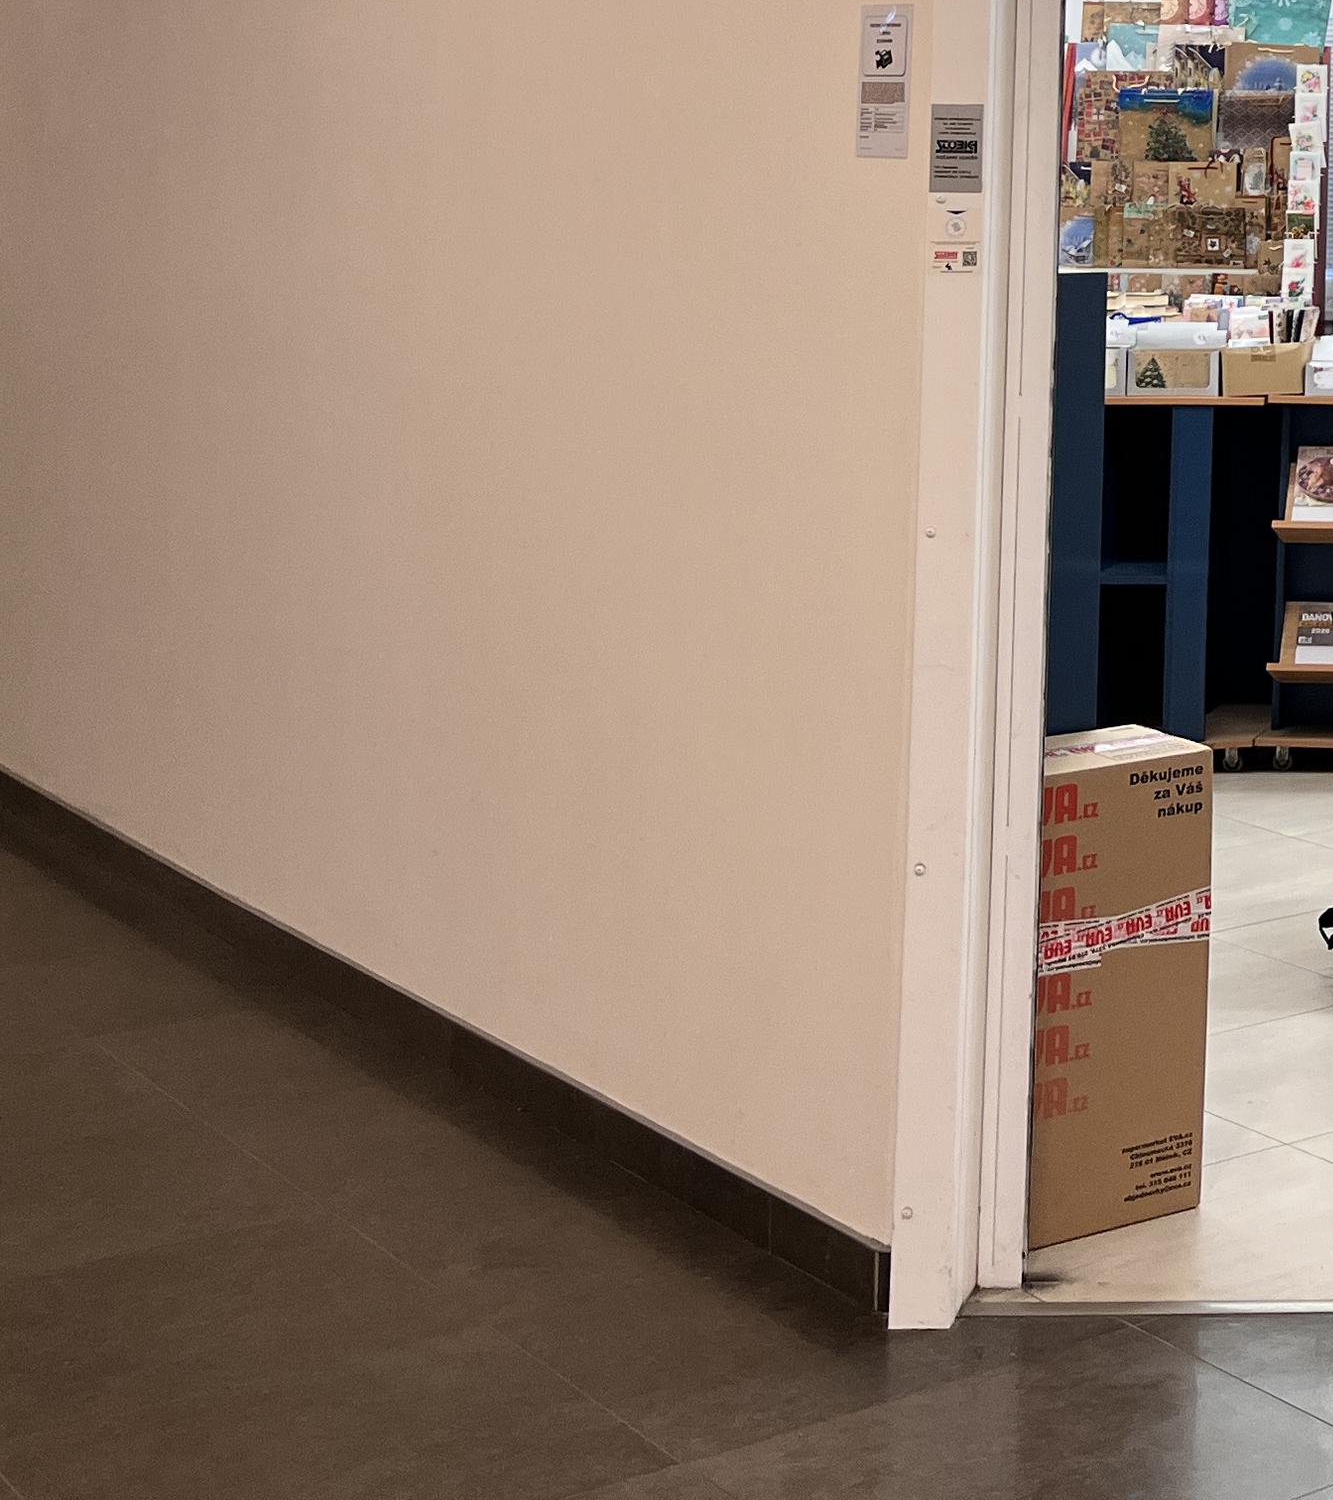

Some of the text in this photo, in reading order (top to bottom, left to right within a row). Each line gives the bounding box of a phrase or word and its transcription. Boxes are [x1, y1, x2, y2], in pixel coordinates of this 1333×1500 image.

[1129, 765, 1204, 786] Děkujeme
[1153, 780, 1204, 800] za Váš
[1157, 802, 1204, 818] nákup
